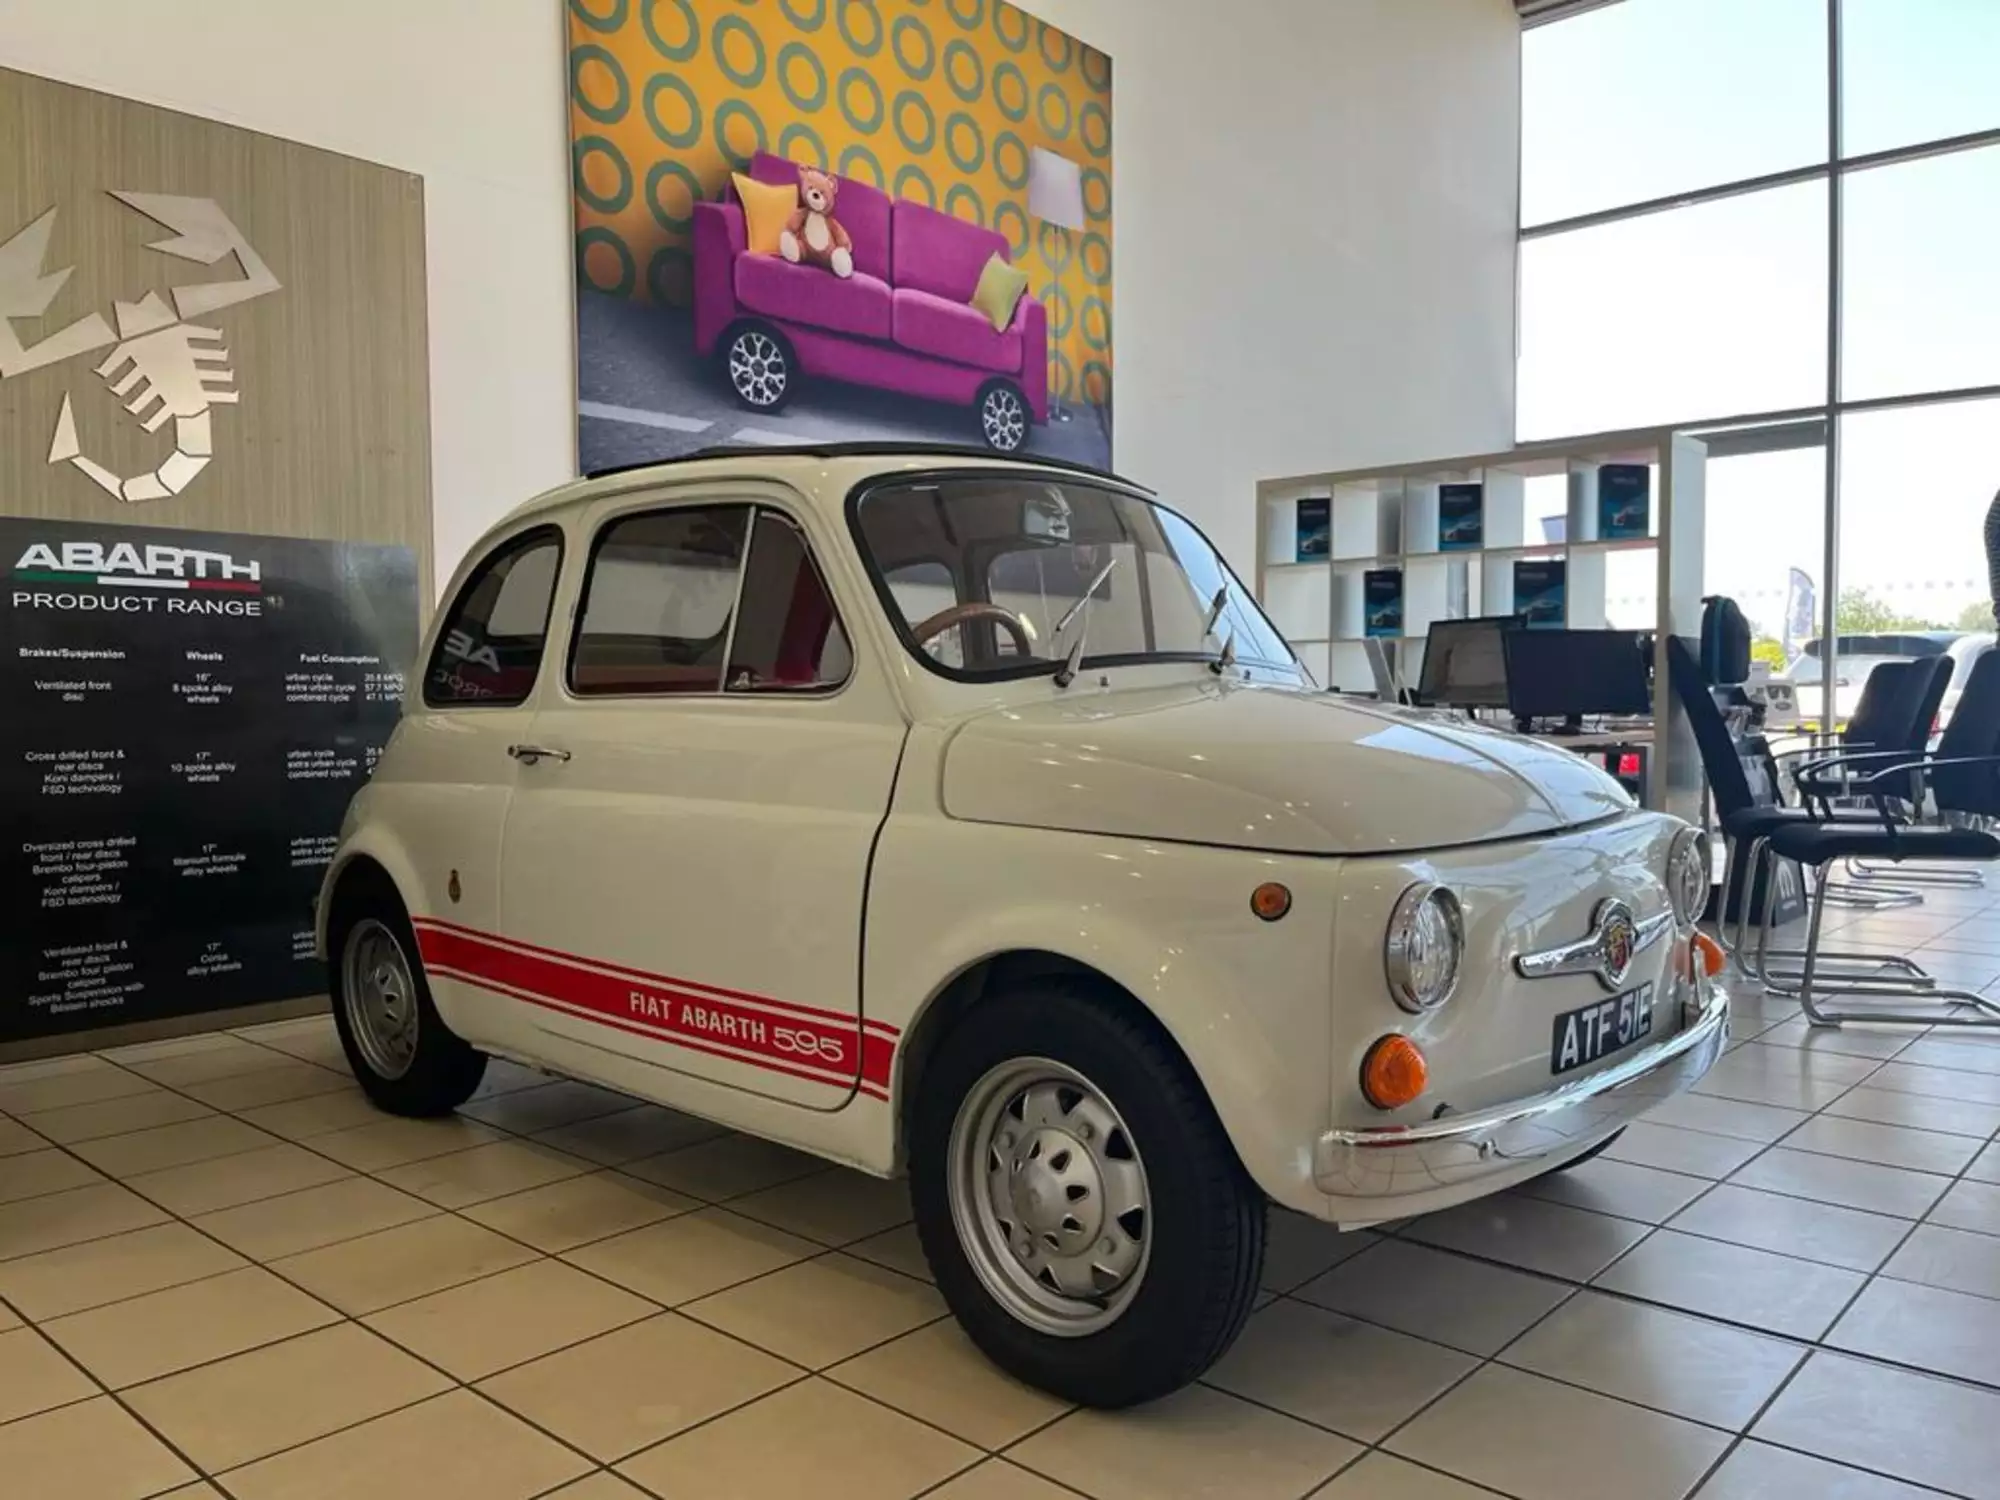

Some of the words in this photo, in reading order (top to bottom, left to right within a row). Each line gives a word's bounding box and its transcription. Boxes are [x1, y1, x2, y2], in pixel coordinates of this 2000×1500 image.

[14, 542, 261, 581] ABARTH
[12, 592, 158, 612] PRODUCT
[167, 598, 262, 616] RANGE
[19, 647, 126, 660] Brakes/Suspension
[186, 651, 224, 661] Wheels
[300, 653, 320, 663] Fuel
[321, 653, 380, 664] Consumption
[34, 680, 87, 690] Ventilated
[88, 681, 112, 690] front
[181, 684, 210, 694] spoke
[211, 683, 233, 694] alloy
[187, 694, 220, 704] wheels
[286, 693, 327, 702] combined
[25, 751, 56, 762] Cross
[91, 750, 115, 760] front
[184, 763, 214, 774] spoke
[214, 762, 236, 773] alloy
[287, 769, 329, 779] combined
[187, 773, 220, 783] wheels
[67, 783, 123, 794] technology
[22, 840, 75, 853] Oversized
[76, 840, 104, 850] cross
[32, 864, 74, 876] Brembo
[67, 893, 122, 906] technology
[42, 945, 94, 959] Ventilated
[95, 941, 119, 952] front
[38, 969, 80, 982] Brembo
[629, 991, 672, 1020] FIAT
[680, 1003, 767, 1044] ABARTH
[772, 1026, 845, 1063] 595
[1559, 1001, 1615, 1069] ATF
[1617, 984, 1652, 1045] 51E
